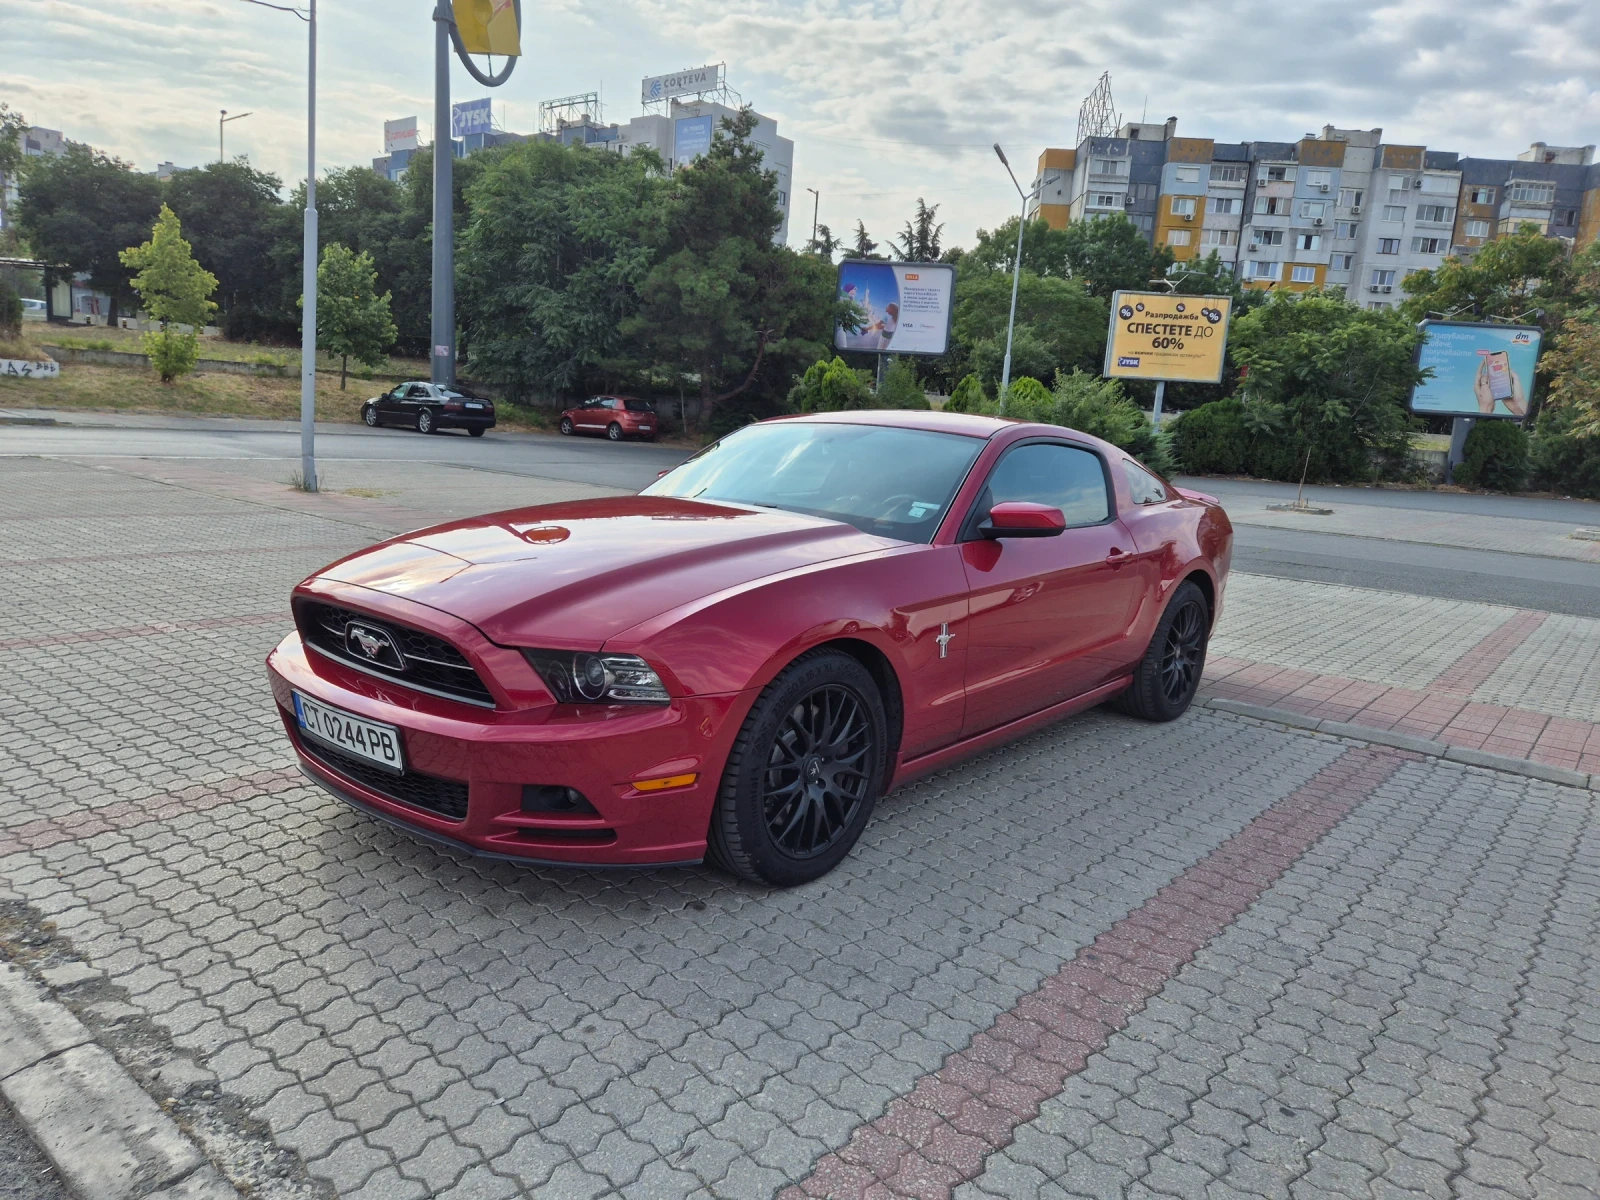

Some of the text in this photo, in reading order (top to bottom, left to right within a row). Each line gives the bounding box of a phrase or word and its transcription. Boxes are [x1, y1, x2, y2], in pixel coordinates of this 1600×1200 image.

[663, 72, 707, 88] CORTEVA
[460, 108, 489, 127] JYSK
[1145, 311, 1199, 321] Разпродажба
[1127, 322, 1213, 339] СПЕСТЕТЕ ДО
[1515, 332, 1529, 340] dm
[1152, 337, 1184, 350] 60%
[1121, 358, 1139, 366] JYSK
[302, 702, 396, 761] CT 0244 PB
